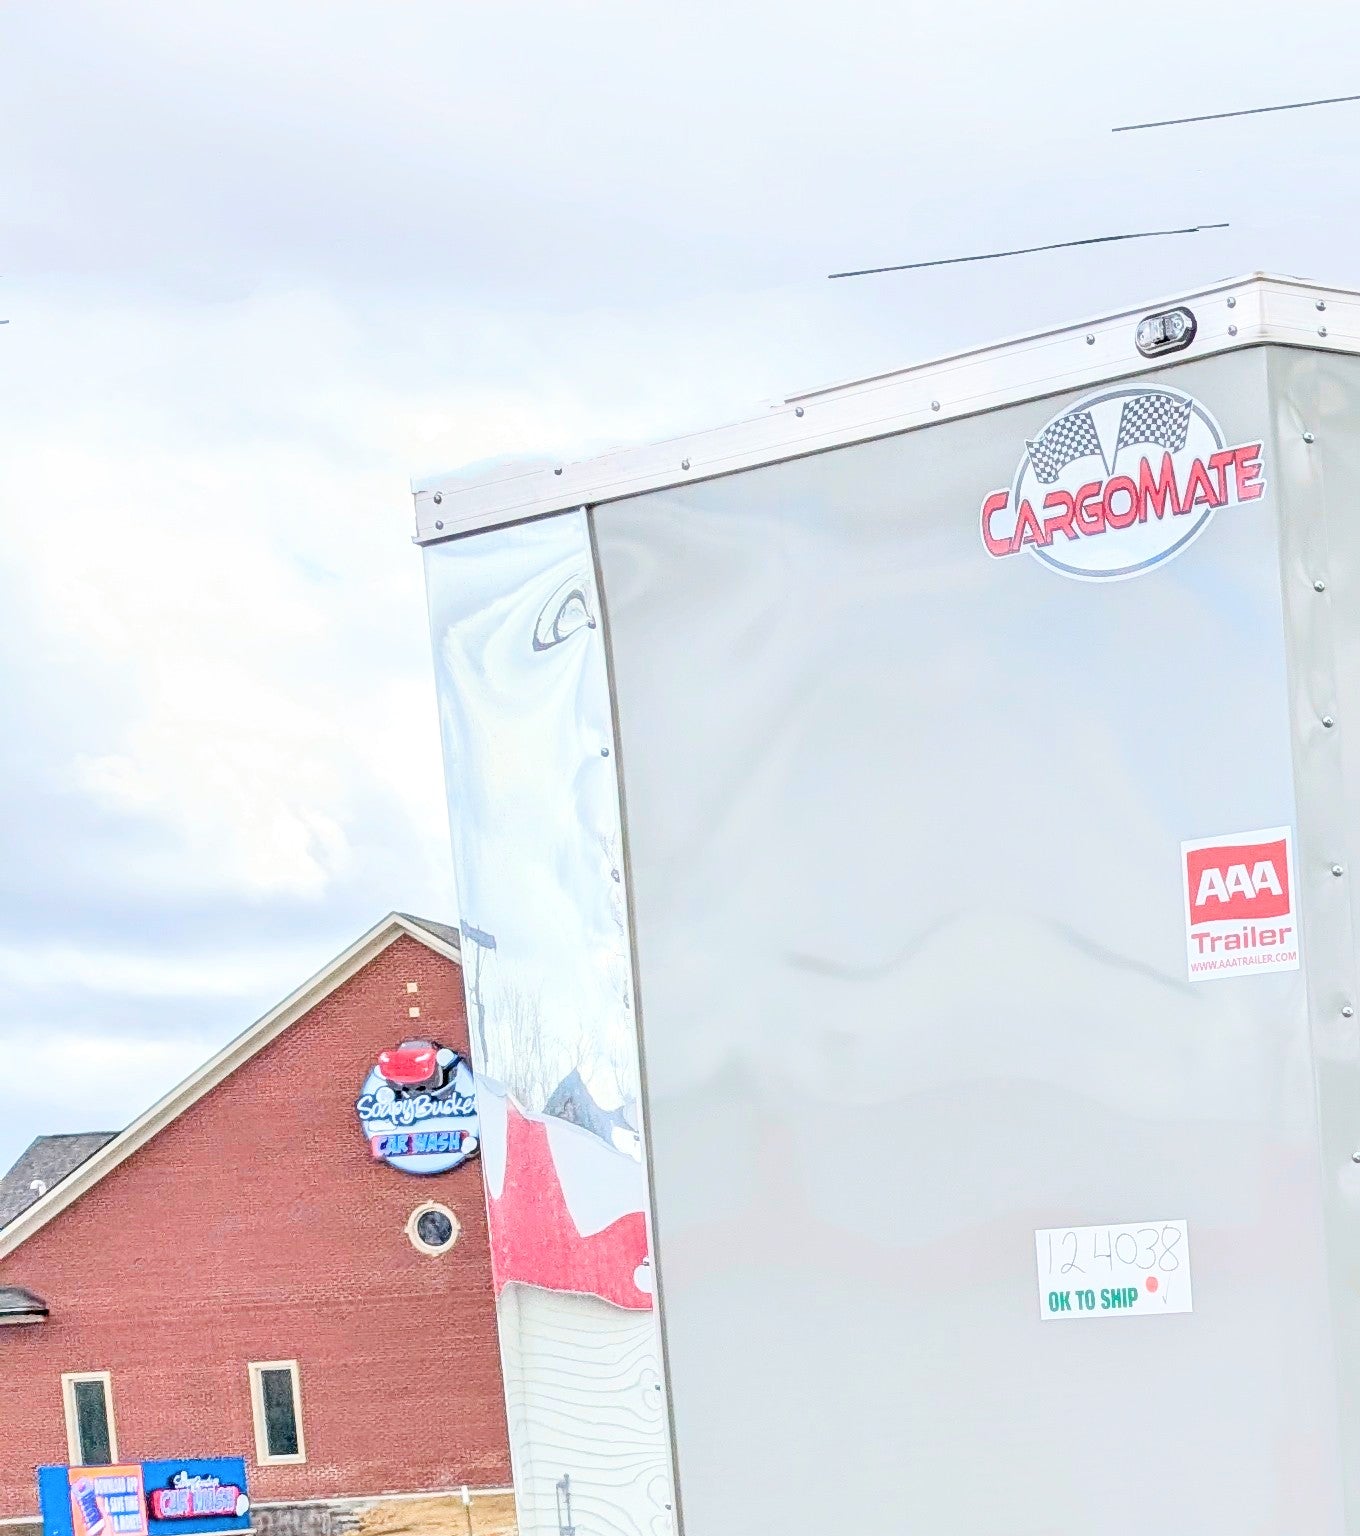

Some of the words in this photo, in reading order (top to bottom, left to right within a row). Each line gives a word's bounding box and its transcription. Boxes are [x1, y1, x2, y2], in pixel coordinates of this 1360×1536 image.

[1195, 860, 1283, 906] AAA
[1191, 926, 1292, 954] Trailer
[1191, 951, 1297, 973] WWW.AAATRAILER.COM
[379, 1134, 408, 1154] CAR
[412, 1131, 460, 1153] WASH
[1049, 1224, 1182, 1275] 124038
[1049, 1291, 1071, 1312] OK
[1075, 1290, 1095, 1310] TO
[1101, 1287, 1138, 1310] SHIP
